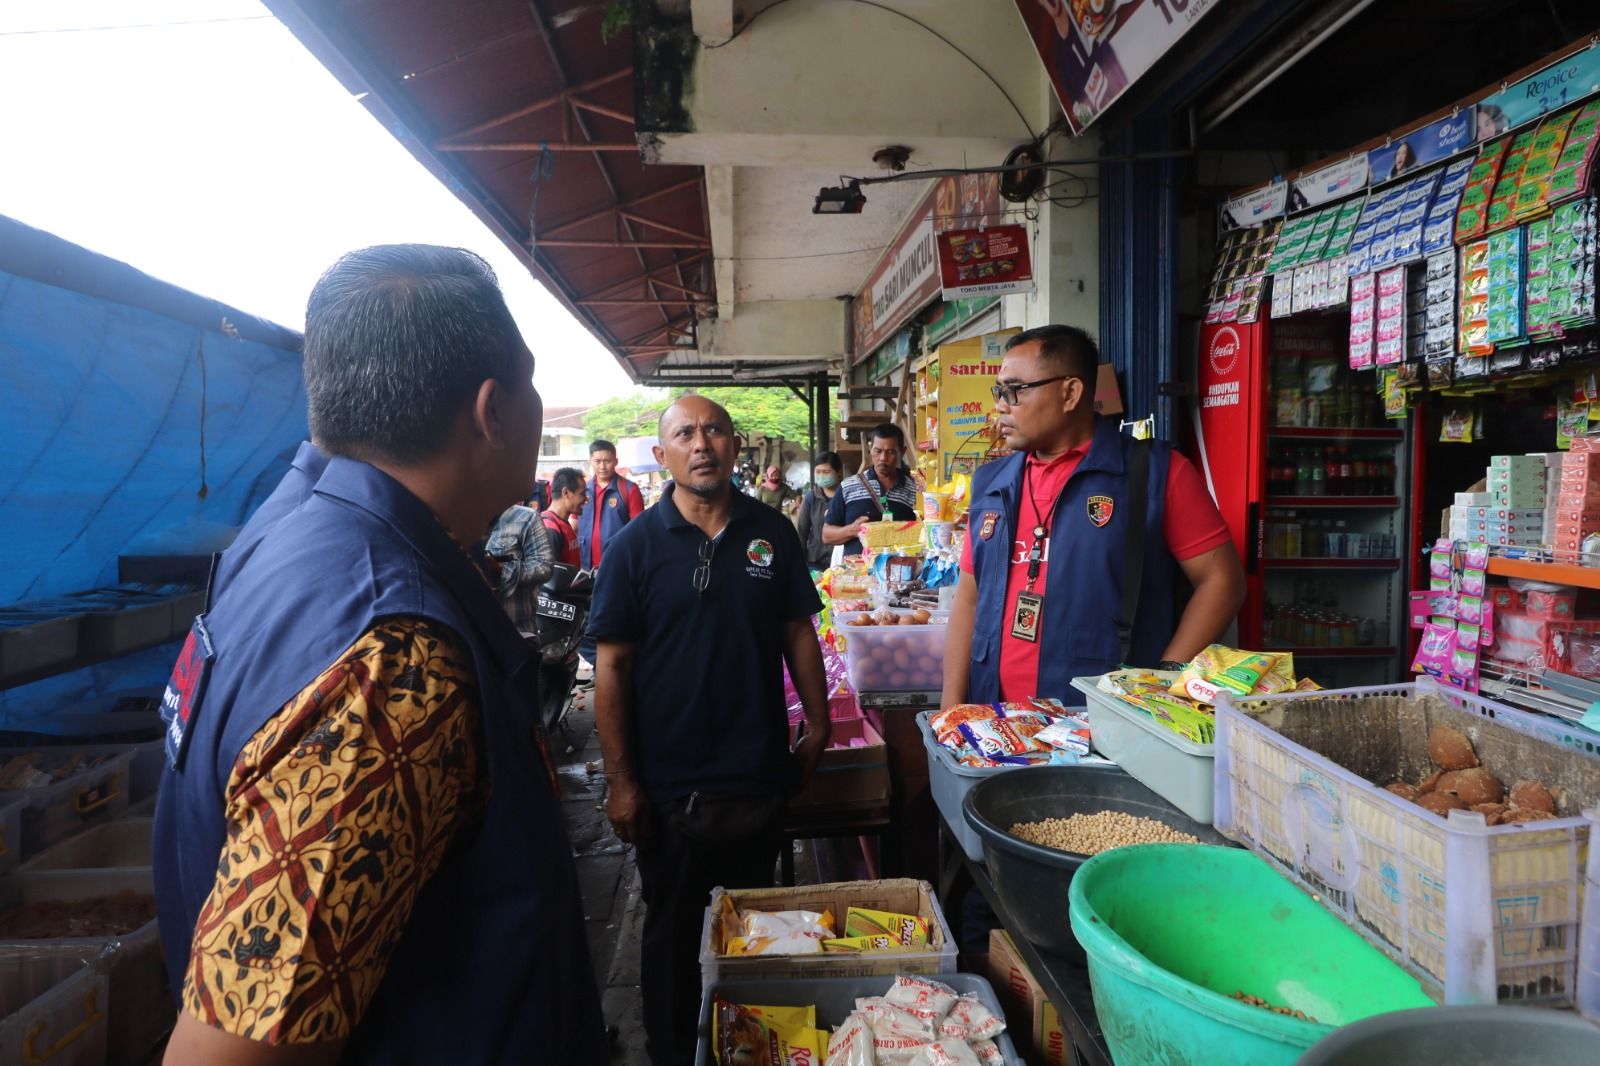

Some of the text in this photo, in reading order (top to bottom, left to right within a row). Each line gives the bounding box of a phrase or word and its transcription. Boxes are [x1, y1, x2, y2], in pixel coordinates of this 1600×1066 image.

[1526, 65, 1578, 99] Rejoice
[884, 272, 900, 311] SARI
[899, 234, 933, 290] MUNCUL
[960, 286, 978, 294] TOKO
[1000, 282, 1016, 291] JAYA
[1213, 343, 1235, 358] Coca-Cola
[949, 361, 1002, 376] sarim
[1203, 393, 1239, 408] SEMANGATMU
[562, 604, 574, 613] EA
